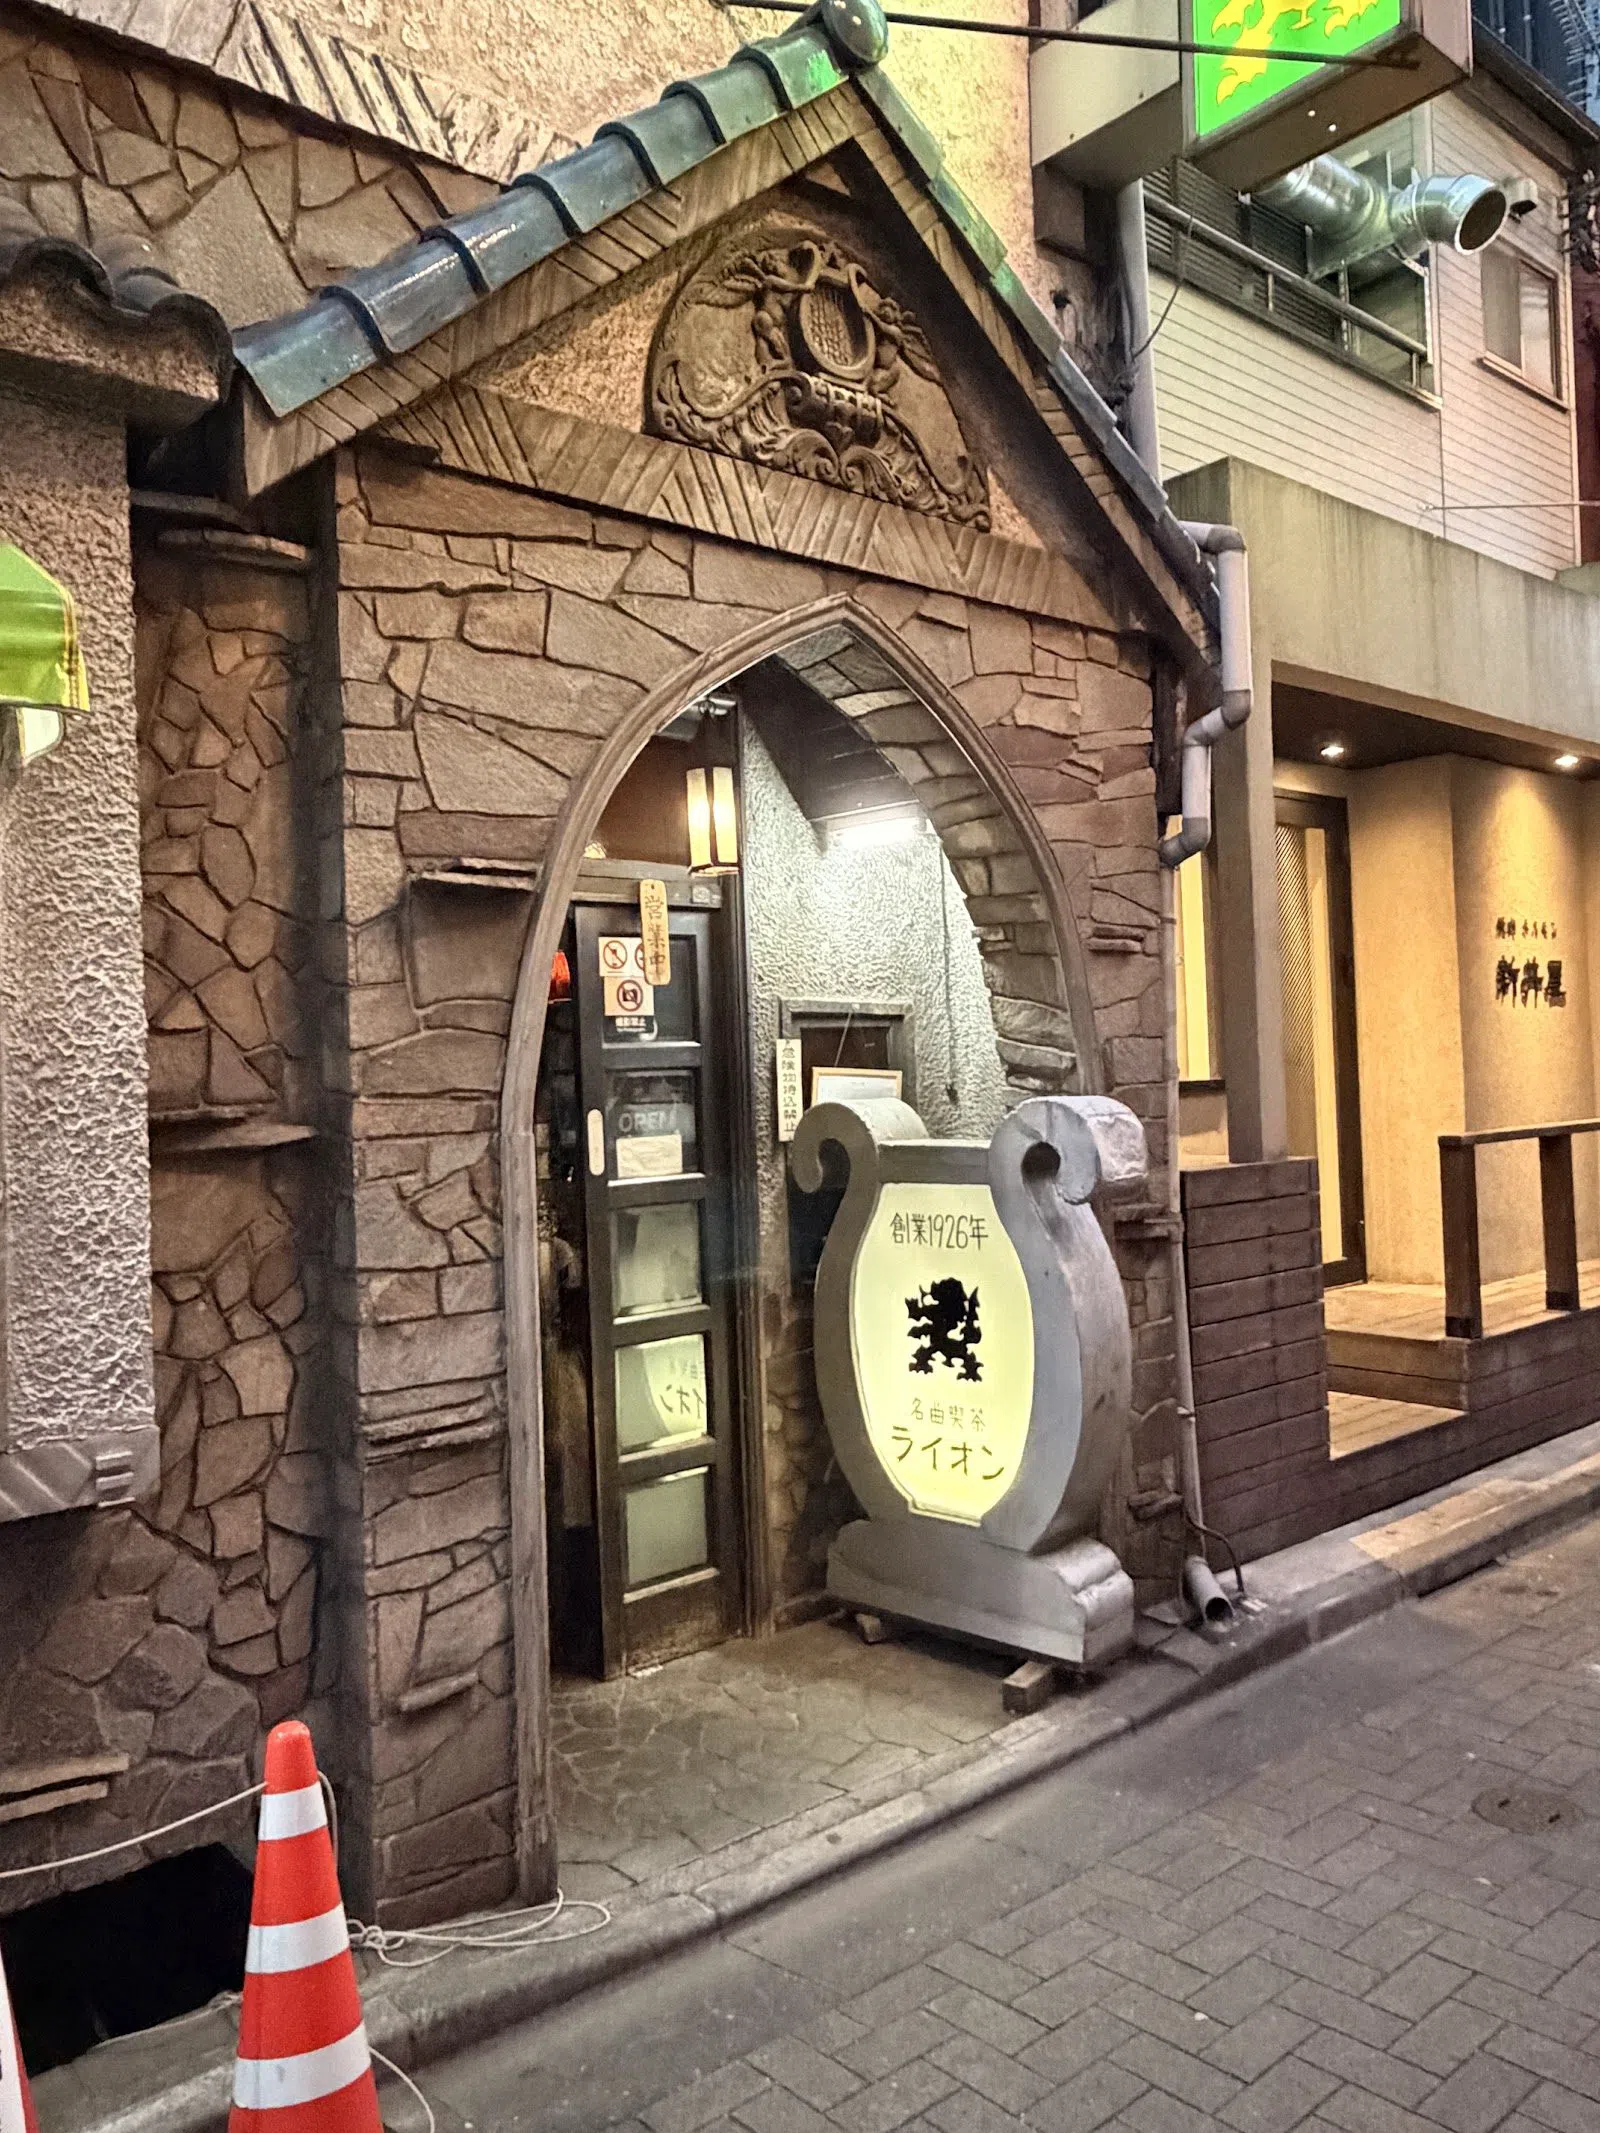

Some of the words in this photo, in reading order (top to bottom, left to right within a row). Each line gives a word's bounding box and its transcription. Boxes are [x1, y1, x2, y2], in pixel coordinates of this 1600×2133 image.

[644, 895, 666, 982] 営業中
[618, 1109, 677, 1133] OPEN
[889, 1211, 989, 1250] 創業1926年
[909, 1397, 987, 1433] 名曲喫茶
[889, 1425, 1005, 1481] ライオン
